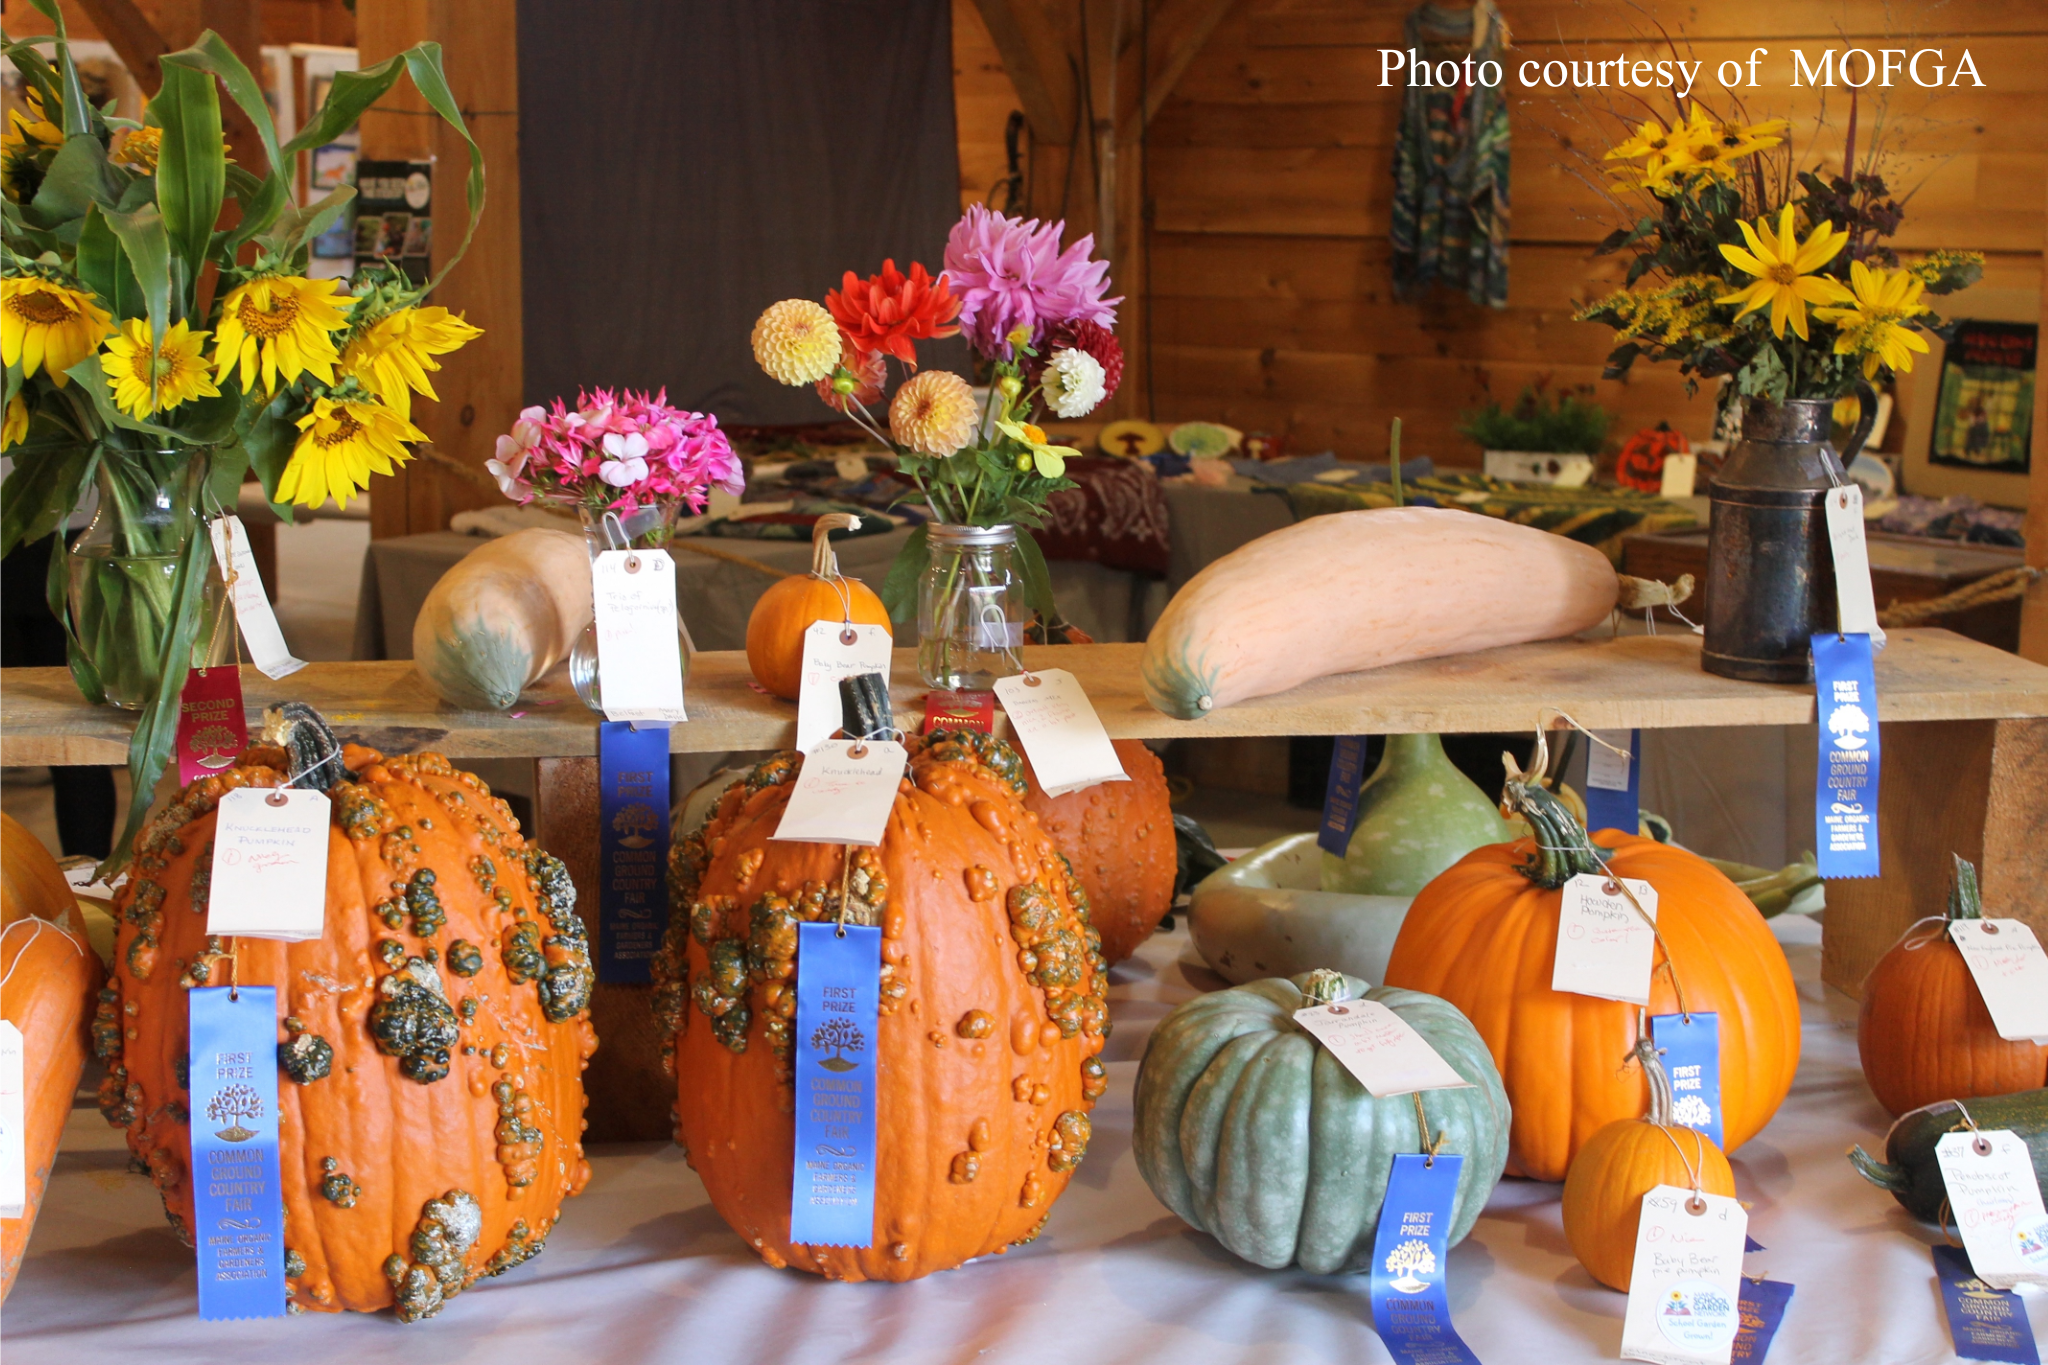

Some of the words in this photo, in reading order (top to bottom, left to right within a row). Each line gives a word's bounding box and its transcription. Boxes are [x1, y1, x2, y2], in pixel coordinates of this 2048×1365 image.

[814, 658, 832, 672] Baby
[1832, 680, 1859, 692] FIRST
[1834, 692, 1861, 703] PRIZE
[181, 698, 236, 713] SECOND
[191, 710, 230, 723] PRIZE
[1830, 750, 1869, 763] COMMON
[1830, 764, 1867, 776] GROUND
[618, 771, 654, 785] FIRST
[1828, 776, 1868, 789] COUNTRY
[618, 786, 653, 798] PRIZE
[1837, 788, 1857, 801] FAIR
[225, 822, 312, 834] KNUCKLEHEAD
[238, 835, 296, 847] PUMPKIN
[613, 851, 656, 864] COMMON
[614, 864, 655, 877] GROUND
[612, 878, 658, 891] COUNTRY
[624, 892, 646, 904] FAIR
[1581, 906, 1630, 924] Pumpkin
[822, 987, 857, 999] FIRST
[822, 1001, 856, 1013] PRIZE
[216, 1052, 253, 1066] FIRST
[216, 1066, 254, 1079] PRIZE
[1673, 1065, 1702, 1079] FIRST
[811, 1077, 863, 1093] COMMON
[1674, 1078, 1702, 1091] PRIZE
[813, 1093, 861, 1109] GROUND
[810, 1108, 863, 1125] COUNTRY
[825, 1125, 850, 1140] FAIR
[208, 1149, 264, 1165] COMMON
[211, 1165, 263, 1181] GROUND
[832, 1162, 865, 1172] ORGANIC
[813, 1172, 848, 1183] FARMERS
[1944, 1168, 2010, 1181] Penobscot
[209, 1180, 266, 1197] COUNTRY
[1946, 1182, 2019, 1196] Pumpkin
[225, 1198, 253, 1212] FAIR
[1403, 1212, 1434, 1224] FIRST
[1400, 1224, 1431, 1237] PRIZE
[236, 1233, 272, 1244] ORGANIC
[217, 1246, 254, 1258] FARMERS
[218, 1258, 265, 1269] GARDENERS
[1654, 1252, 1684, 1267] Baby
[1689, 1252, 1718, 1265] Bear
[216, 1269, 268, 1281] ASSOCIATION
[1386, 1298, 1435, 1312] COMMON
[1693, 1296, 1727, 1305] SCHOOL
[1693, 1303, 1730, 1311] GARDEN
[1958, 1296, 2010, 1307] COMMON
[1960, 1308, 2013, 1318] COUNTRY
[1962, 1304, 2010, 1312] GROUND
[1390, 1314, 1436, 1325] GROUND
[1668, 1318, 1695, 1327] School
[1696, 1318, 1727, 1328] Garden
[1391, 1325, 1441, 1334] COUNTRY
[1684, 1330, 1714, 1340] Grown!
